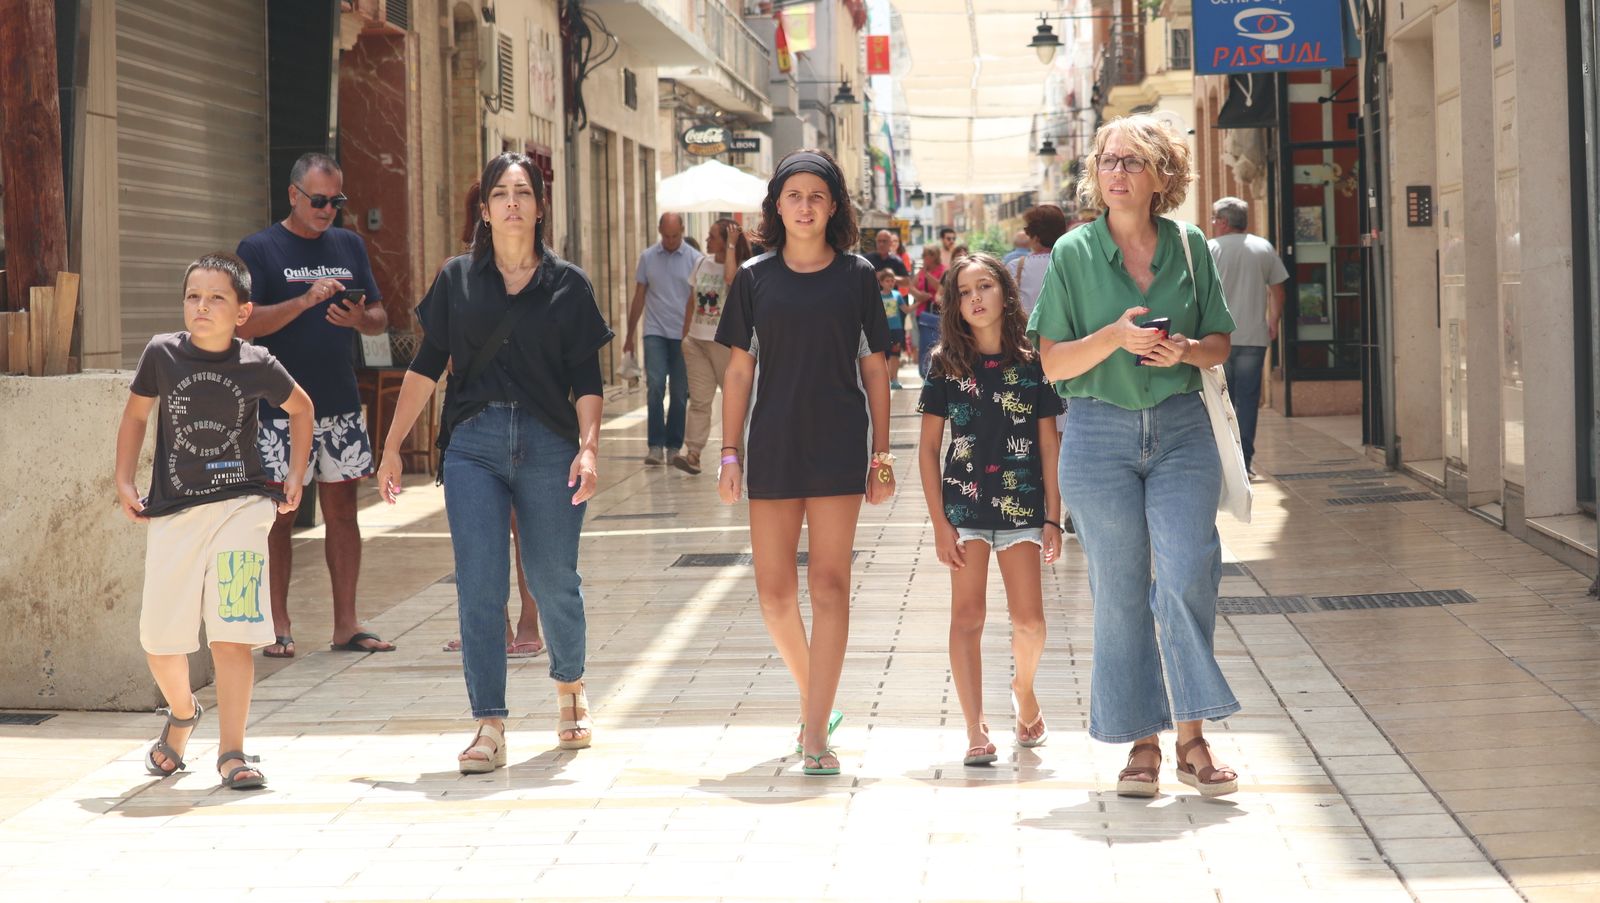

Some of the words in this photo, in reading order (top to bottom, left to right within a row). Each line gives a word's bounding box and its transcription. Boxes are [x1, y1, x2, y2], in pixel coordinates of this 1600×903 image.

[283, 265, 345, 279] Quiksilver
[177, 377, 192, 391] THE
[192, 371, 222, 383] FUTURE
[223, 378, 233, 388] IS
[232, 385, 242, 397] TO
[182, 424, 193, 436] TO
[193, 420, 227, 433] PREDICT
[217, 550, 264, 584] KEEP
